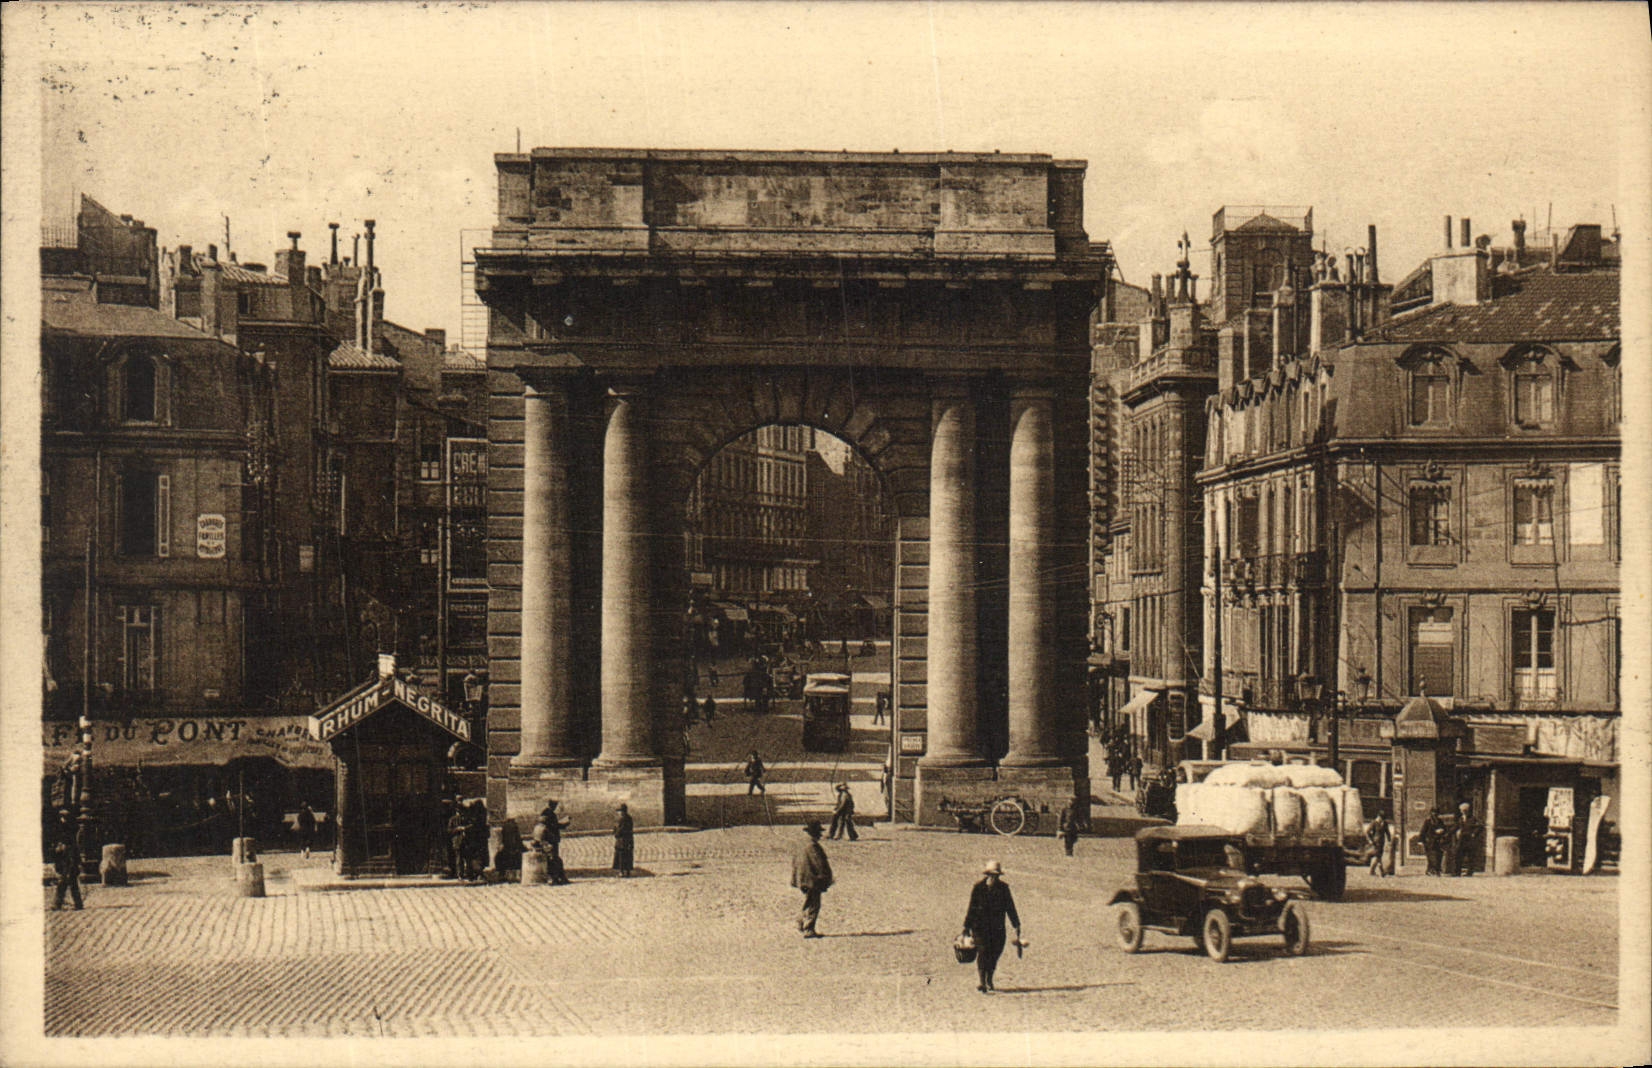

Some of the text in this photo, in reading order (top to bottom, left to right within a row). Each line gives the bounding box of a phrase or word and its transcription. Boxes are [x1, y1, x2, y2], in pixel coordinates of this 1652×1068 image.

[105, 725, 136, 742] DU
[145, 719, 247, 746] PONT
[322, 690, 379, 738] RHUM
[394, 680, 470, 739] NEGRITA
